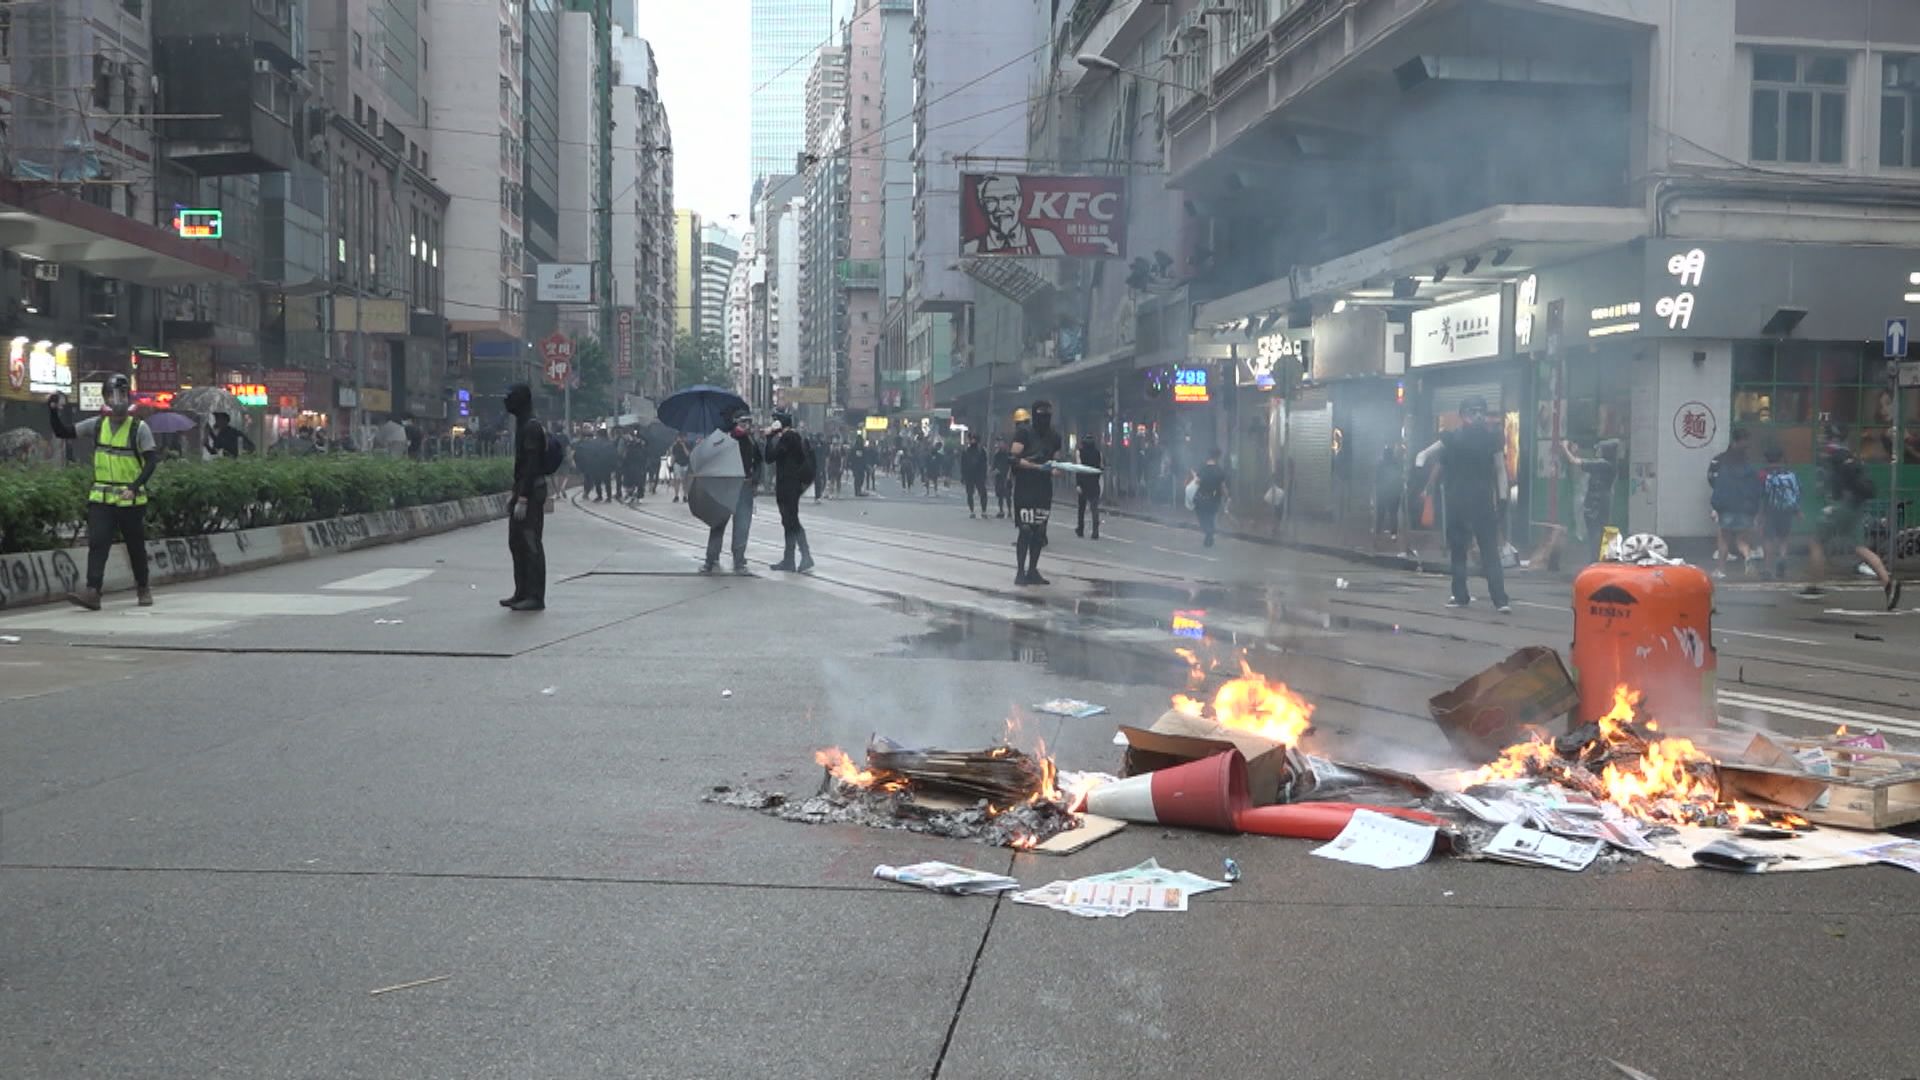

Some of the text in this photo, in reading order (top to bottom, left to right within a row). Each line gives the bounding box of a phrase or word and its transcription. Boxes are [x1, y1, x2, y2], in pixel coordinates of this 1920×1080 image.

[1026, 191, 1118, 221] KFC
[1175, 370, 1206, 385] 298
[1681, 411, 1707, 439] 麵
[1590, 605, 1632, 618] RESIST
